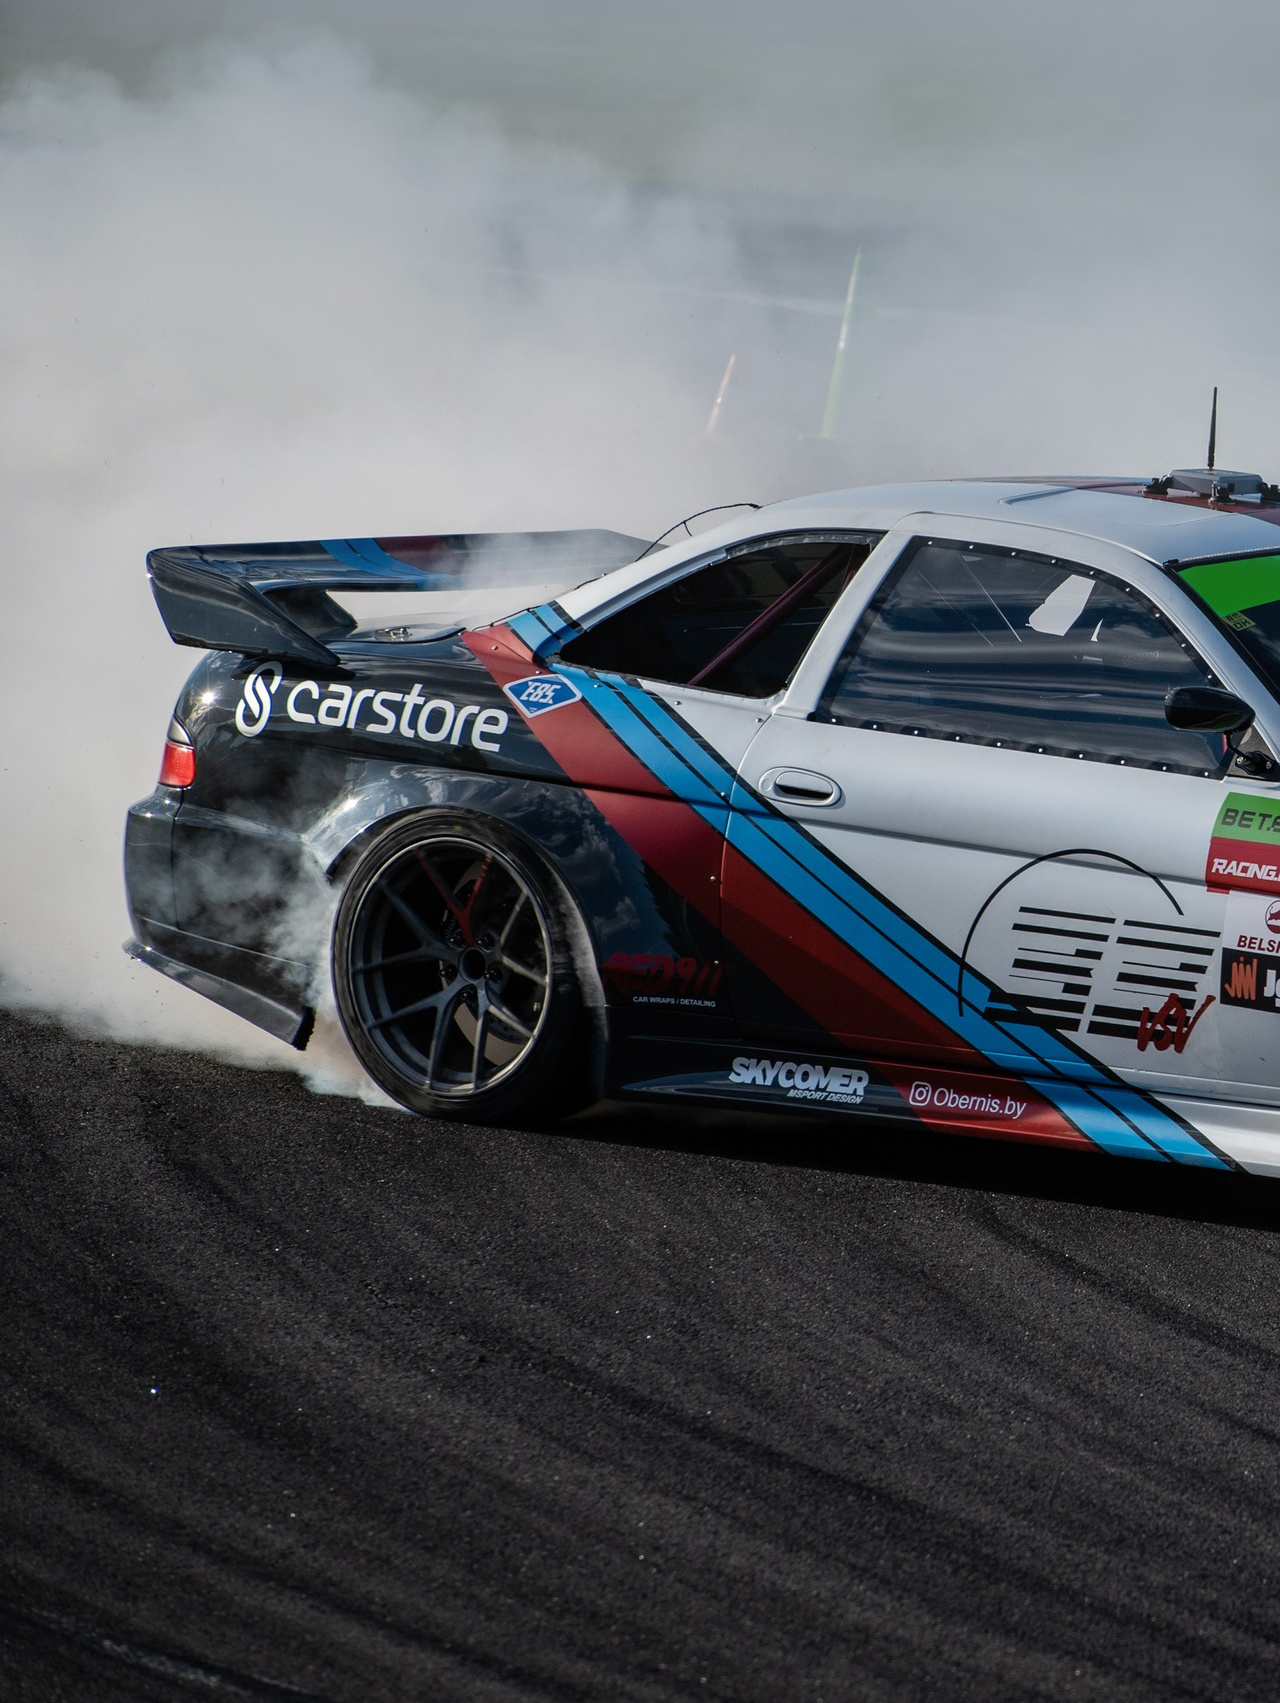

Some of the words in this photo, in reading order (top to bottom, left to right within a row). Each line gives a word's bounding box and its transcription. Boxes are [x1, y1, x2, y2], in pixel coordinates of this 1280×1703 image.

[287, 680, 509, 752] carstore
[649, 996, 675, 1005] WRAPS
[680, 998, 716, 1008] DETAILING
[728, 1056, 869, 1096] SKYCOMER
[787, 1089, 828, 1101] MSPORT
[826, 1093, 864, 1105] DESIGN
[934, 1087, 1027, 1120] Obernis.by
